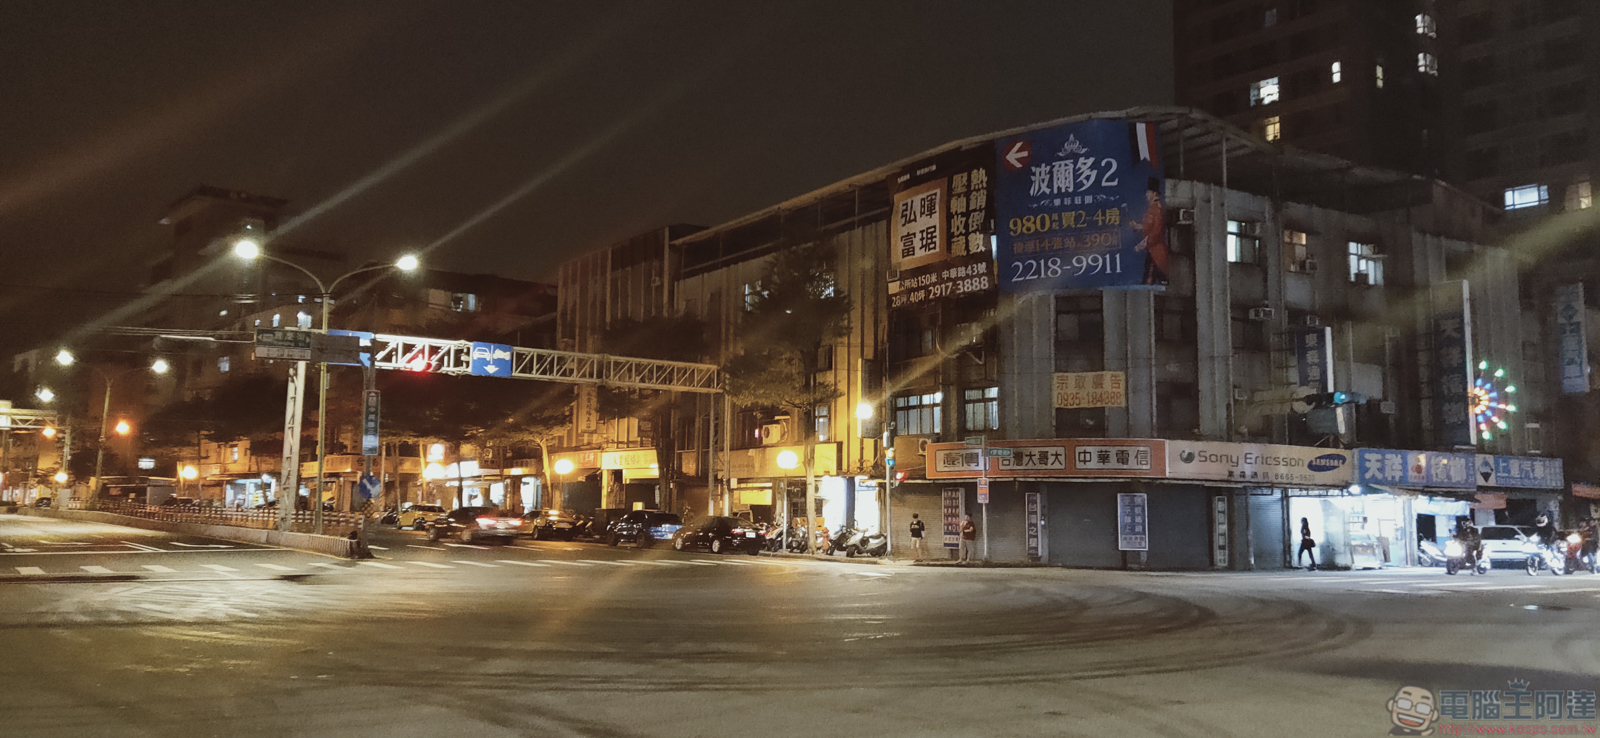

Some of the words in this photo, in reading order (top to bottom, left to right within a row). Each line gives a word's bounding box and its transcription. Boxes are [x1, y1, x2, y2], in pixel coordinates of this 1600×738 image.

[1029, 156, 1118, 197] 波爾多2
[941, 262, 987, 280] 中華路43號
[1011, 252, 1122, 282] 2218-9911
[928, 276, 988, 299] 2917-3888
[1001, 450, 1063, 467] 台灣大哥大
[1078, 449, 1149, 466] 中華電信
[1197, 450, 1240, 467] Sony
[1244, 452, 1305, 468] Ericsson
[1363, 453, 1403, 482] 天祥
